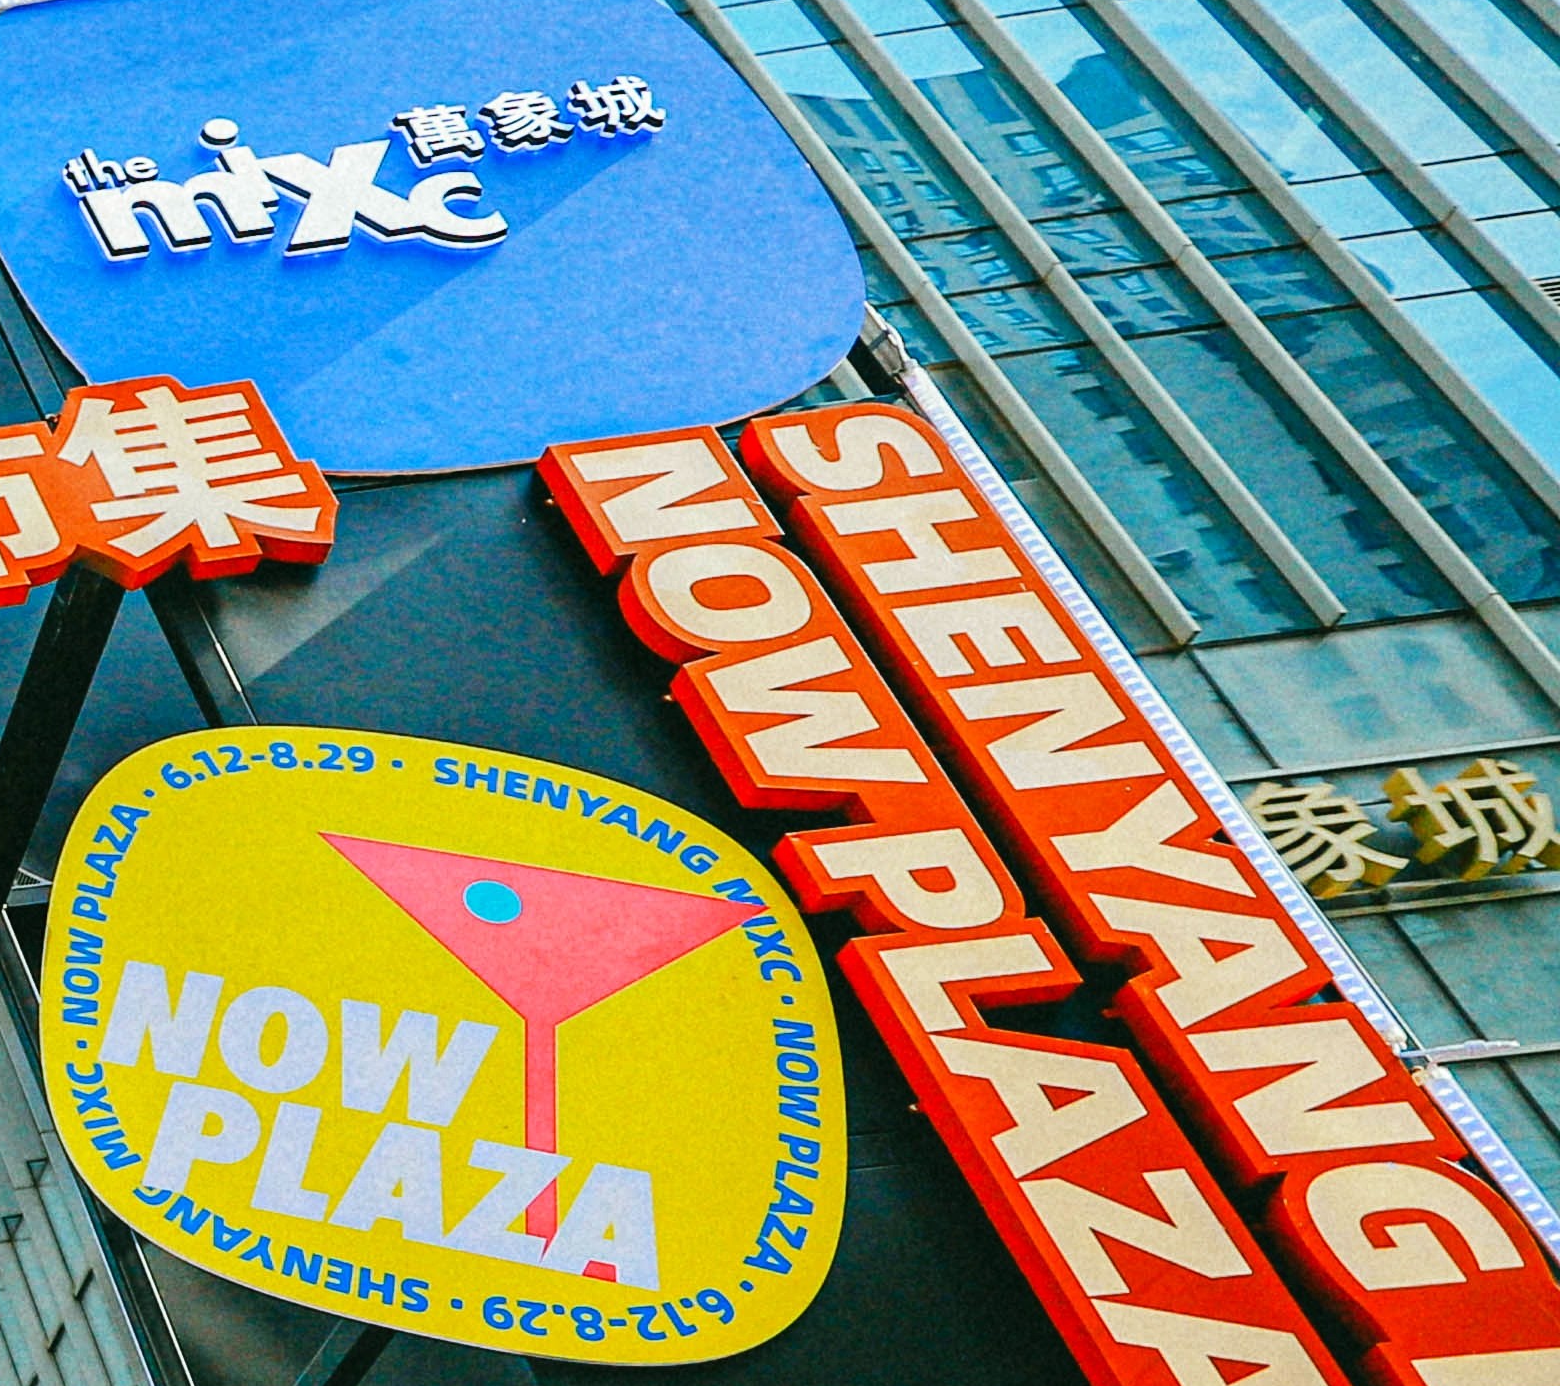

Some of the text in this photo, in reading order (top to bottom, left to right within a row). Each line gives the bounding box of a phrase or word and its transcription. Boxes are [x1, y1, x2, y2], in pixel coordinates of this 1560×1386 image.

[63, 148, 159, 190] the
[390, 74, 668, 168] 萬象城
[570, 436, 927, 790] NOW
[770, 416, 1526, 1292] SHENYANG
[63, 743, 822, 1342] SHENYANG MIXC NOW PLAZA 6.12-8.29 SHENYANG MIXC NOW PLAZA 6.12-8.29
[98, 961, 499, 1128] NOW
[141, 1082, 660, 1292] PLAZA
